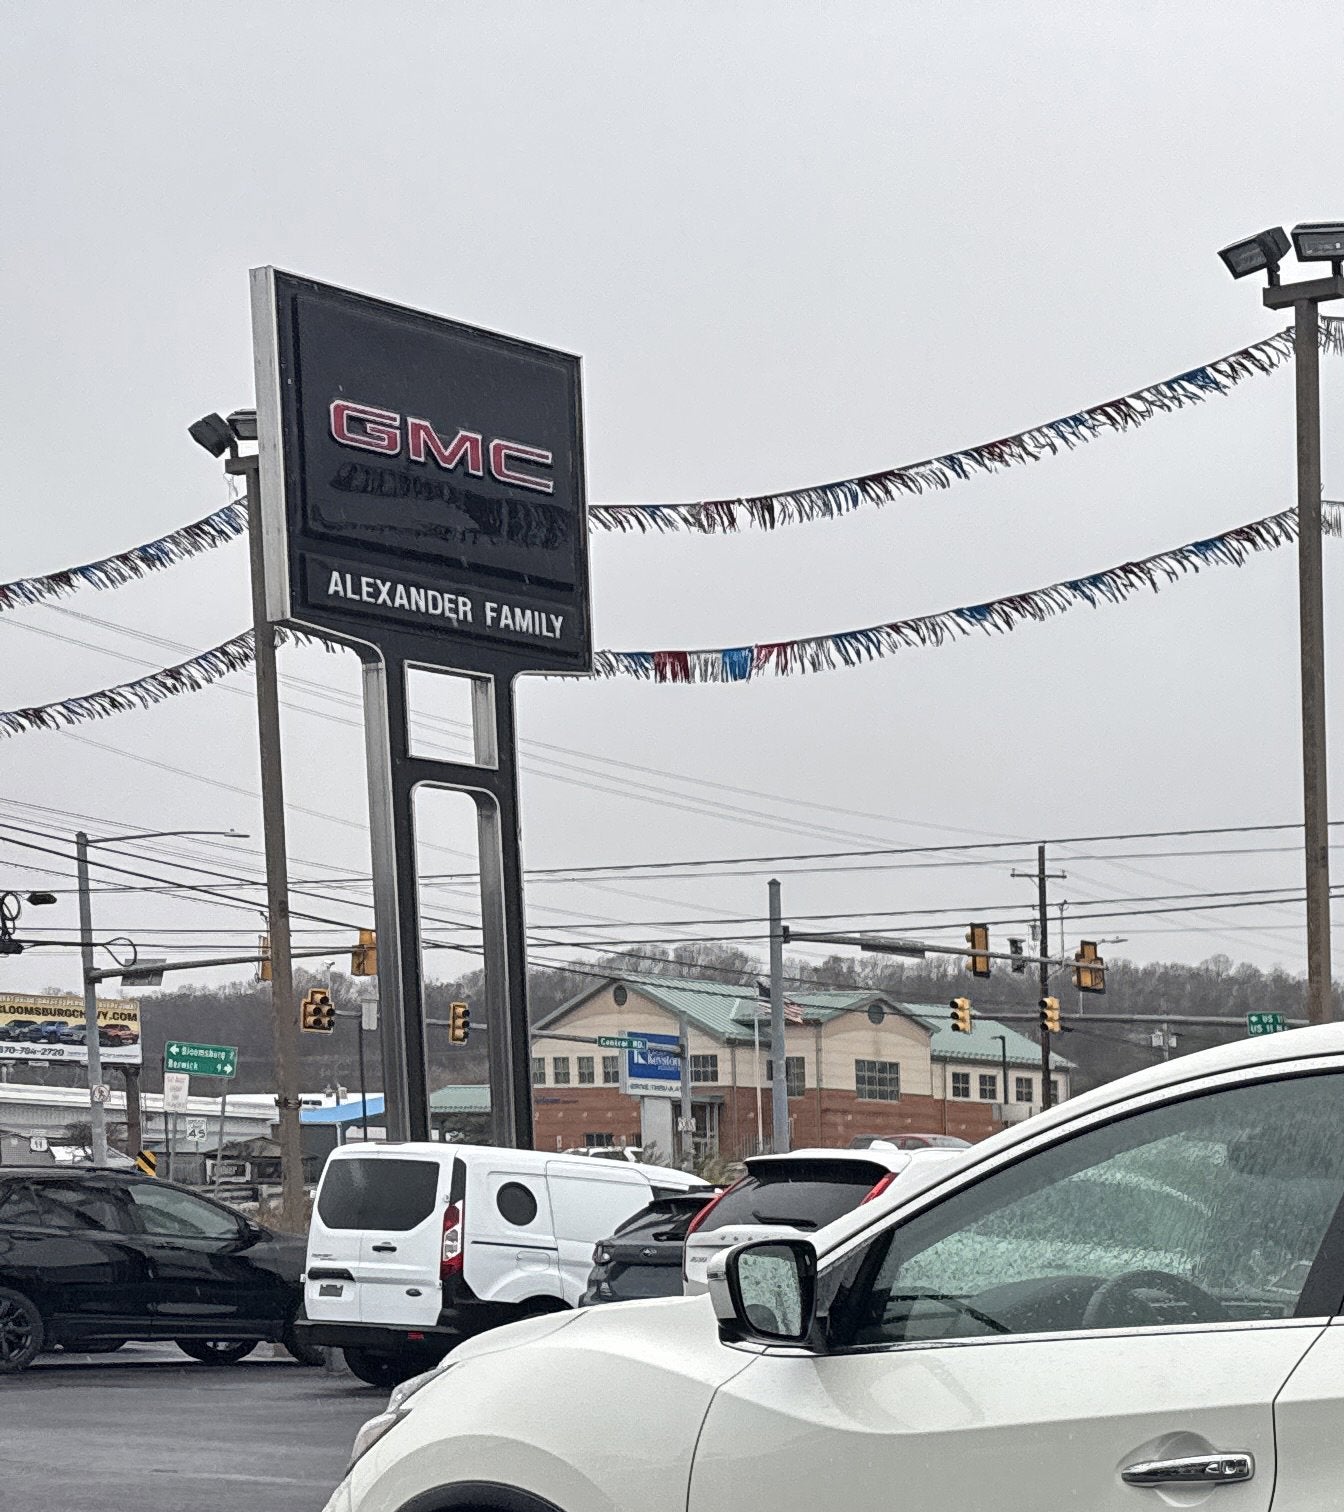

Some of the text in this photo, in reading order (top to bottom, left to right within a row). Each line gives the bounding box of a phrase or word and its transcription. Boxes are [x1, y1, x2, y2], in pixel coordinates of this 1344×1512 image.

[330, 399, 555, 494] GMC
[327, 570, 564, 640] ALEXANDER FAMILY
[167, 1058, 199, 1071] Berwick
[181, 1045, 226, 1061] Bloomsburg
